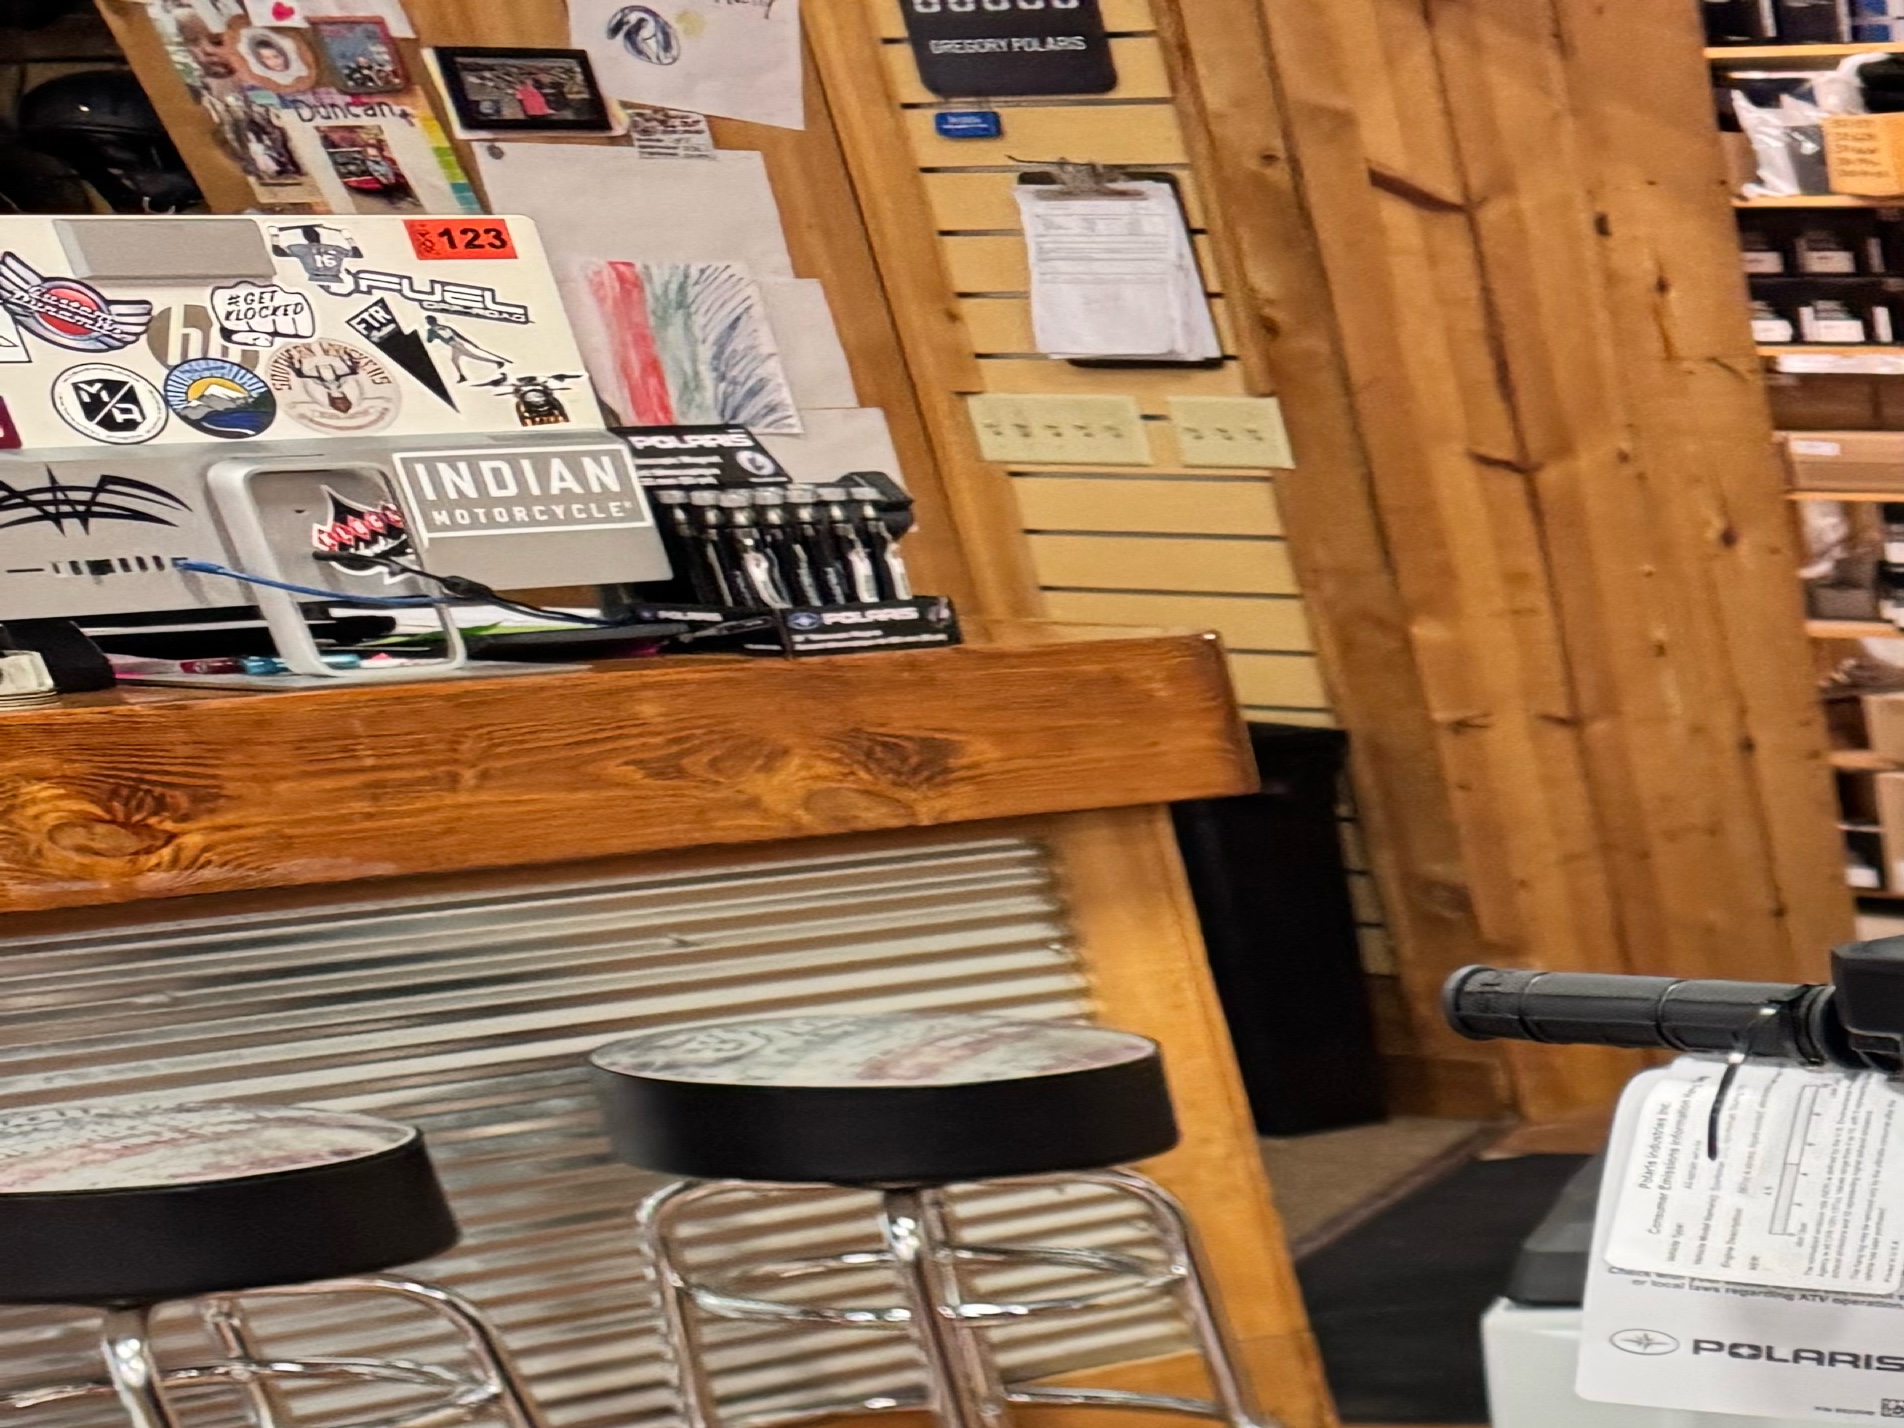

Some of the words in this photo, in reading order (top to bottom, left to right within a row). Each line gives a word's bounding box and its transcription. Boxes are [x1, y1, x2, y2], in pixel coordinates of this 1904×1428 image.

[929, 37, 1009, 54] GREGORY
[1012, 36, 1087, 52] POLARIS
[439, 227, 507, 251] 123
[227, 290, 276, 306] #GET
[350, 271, 528, 315] FUEL
[224, 302, 305, 322] KLOCKED
[627, 434, 755, 450] POLARIS
[414, 455, 622, 501] INDIAN
[433, 503, 624, 527] MOTORCYCLE
[822, 607, 920, 626] POLARIS
